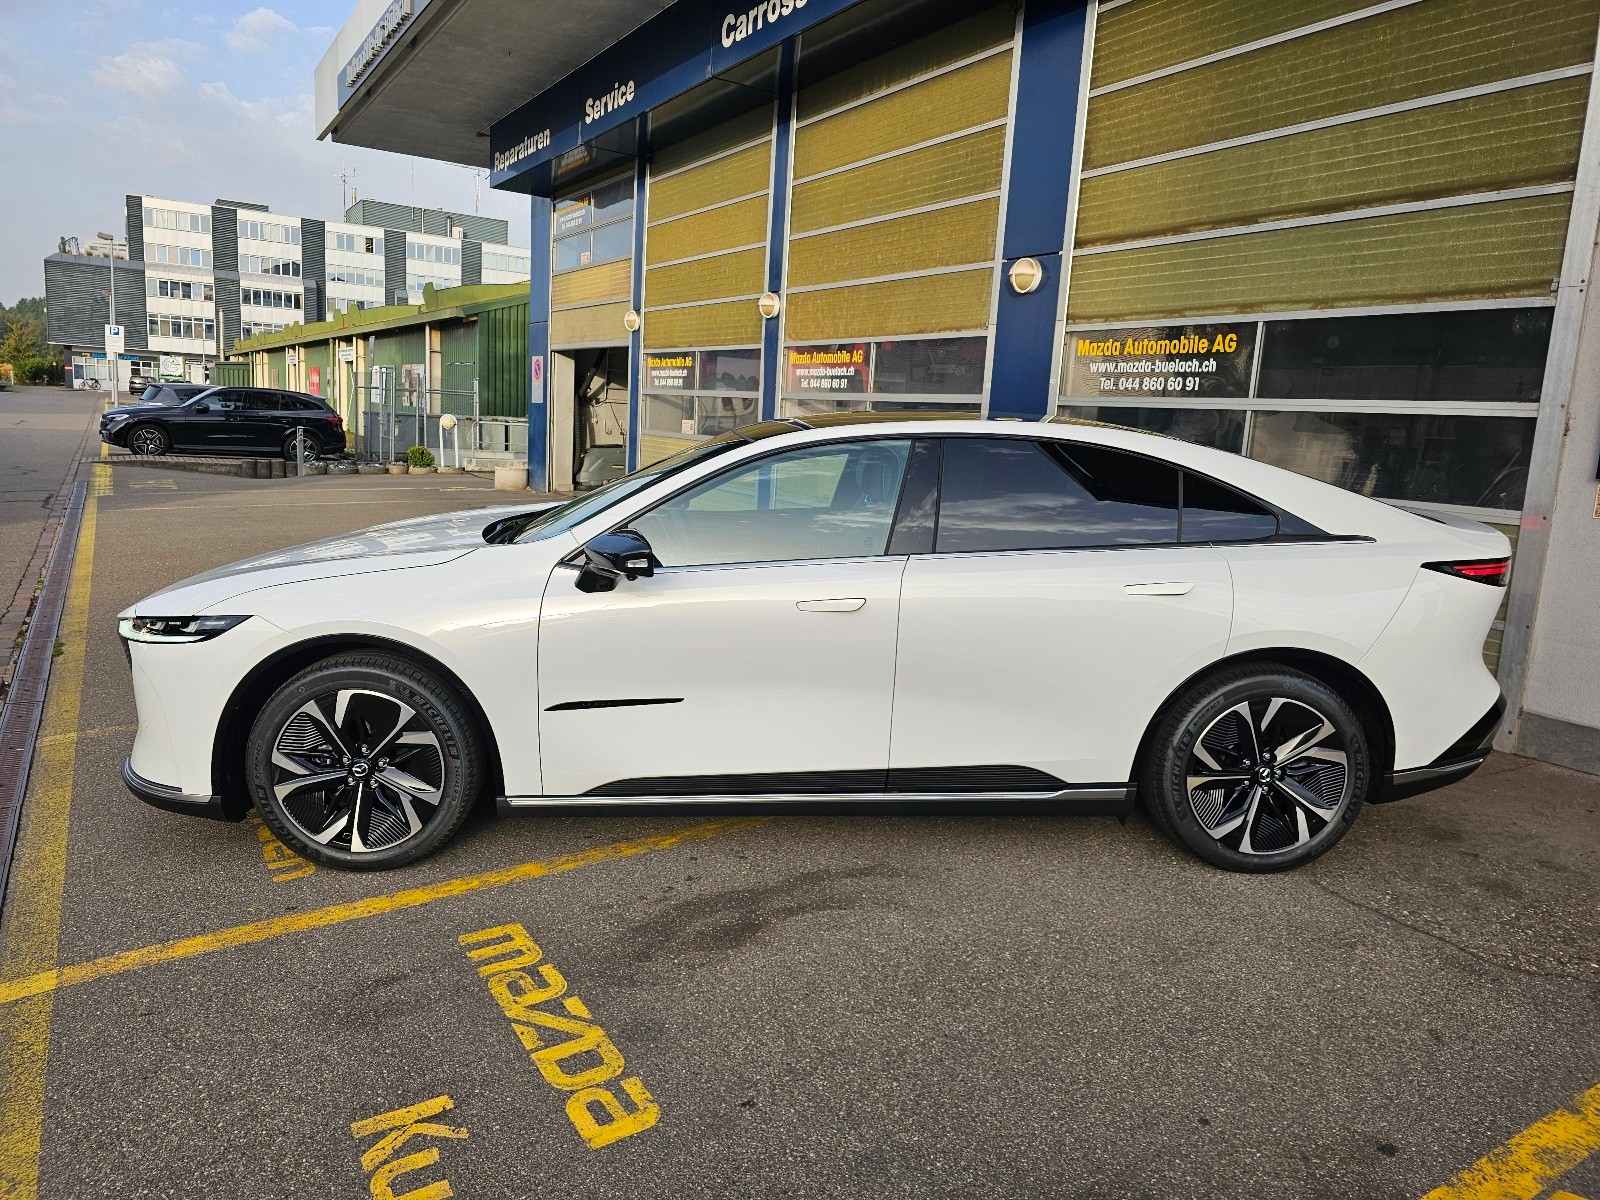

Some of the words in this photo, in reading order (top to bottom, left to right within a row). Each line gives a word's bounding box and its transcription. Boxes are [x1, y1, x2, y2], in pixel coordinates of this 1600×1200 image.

[585, 80, 635, 124] Service
[494, 128, 550, 172] Reparaturen
[790, 352, 810, 364] Mazda
[812, 350, 851, 364] Automobile
[852, 350, 864, 363] AG
[1077, 339, 1120, 356] Mazda
[1123, 334, 1208, 355] Automobile
[1212, 333, 1237, 353] AG
[1090, 358, 1217, 373] www.mazda-buelach.ch
[810, 379, 820, 388] 044
[1100, 378, 1116, 390] Tel.
[1119, 377, 1139, 390] 044
[1142, 377, 1164, 390] 860
[1167, 377, 1182, 390] 60
[1185, 377, 1199, 390] 91
[413, 694, 459, 757] MICHELIN
[1172, 732, 1191, 802] MICHELIN
[457, 923, 662, 1150] mazda
